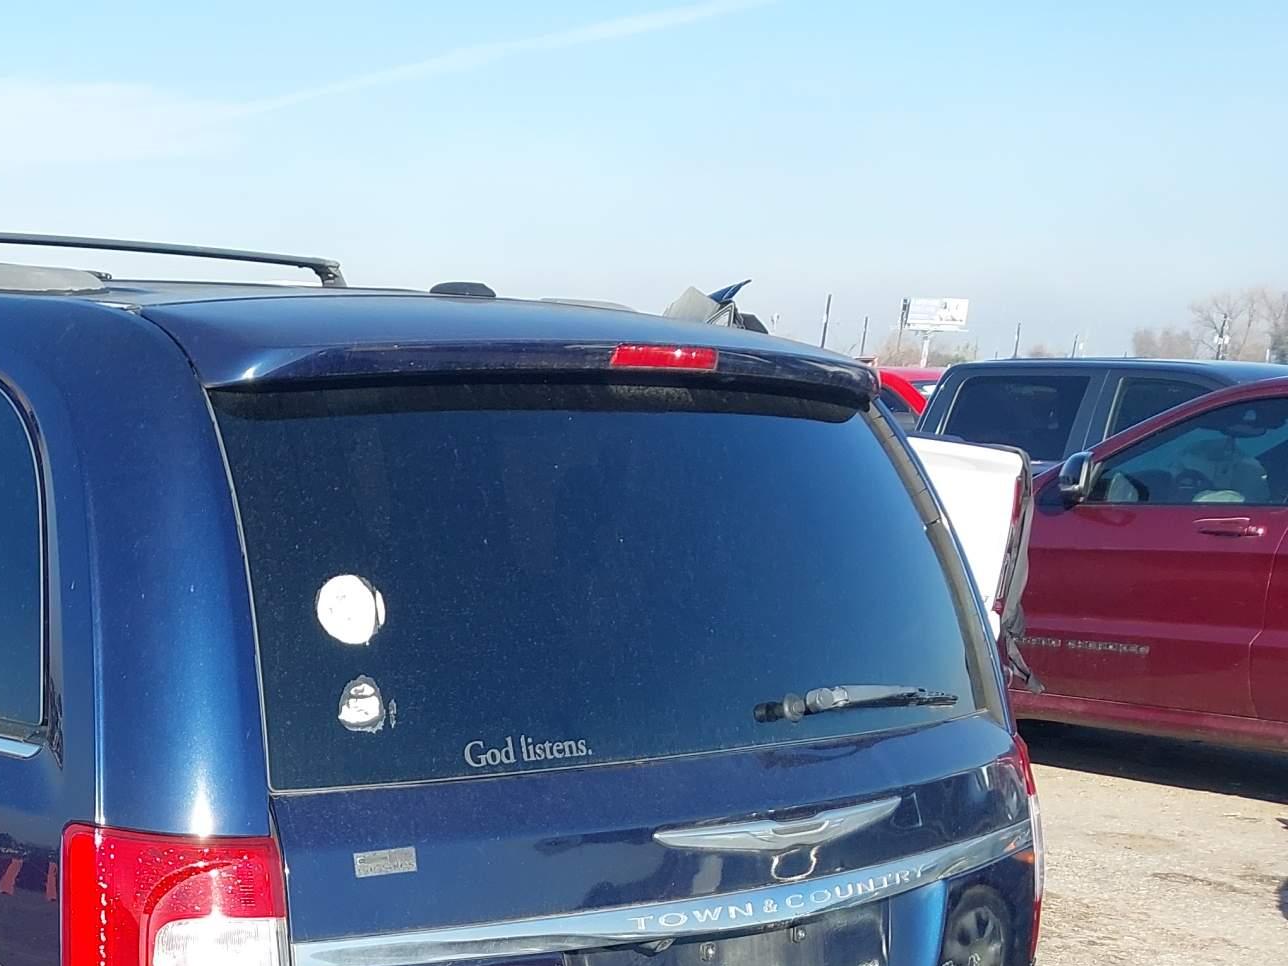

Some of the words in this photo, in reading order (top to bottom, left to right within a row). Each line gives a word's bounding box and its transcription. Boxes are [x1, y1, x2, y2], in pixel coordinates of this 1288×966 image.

[464, 735, 516, 768] God
[520, 734, 593, 762] listens.
[628, 902, 754, 930] TOWN
[785, 863, 927, 909] COUNTRY
